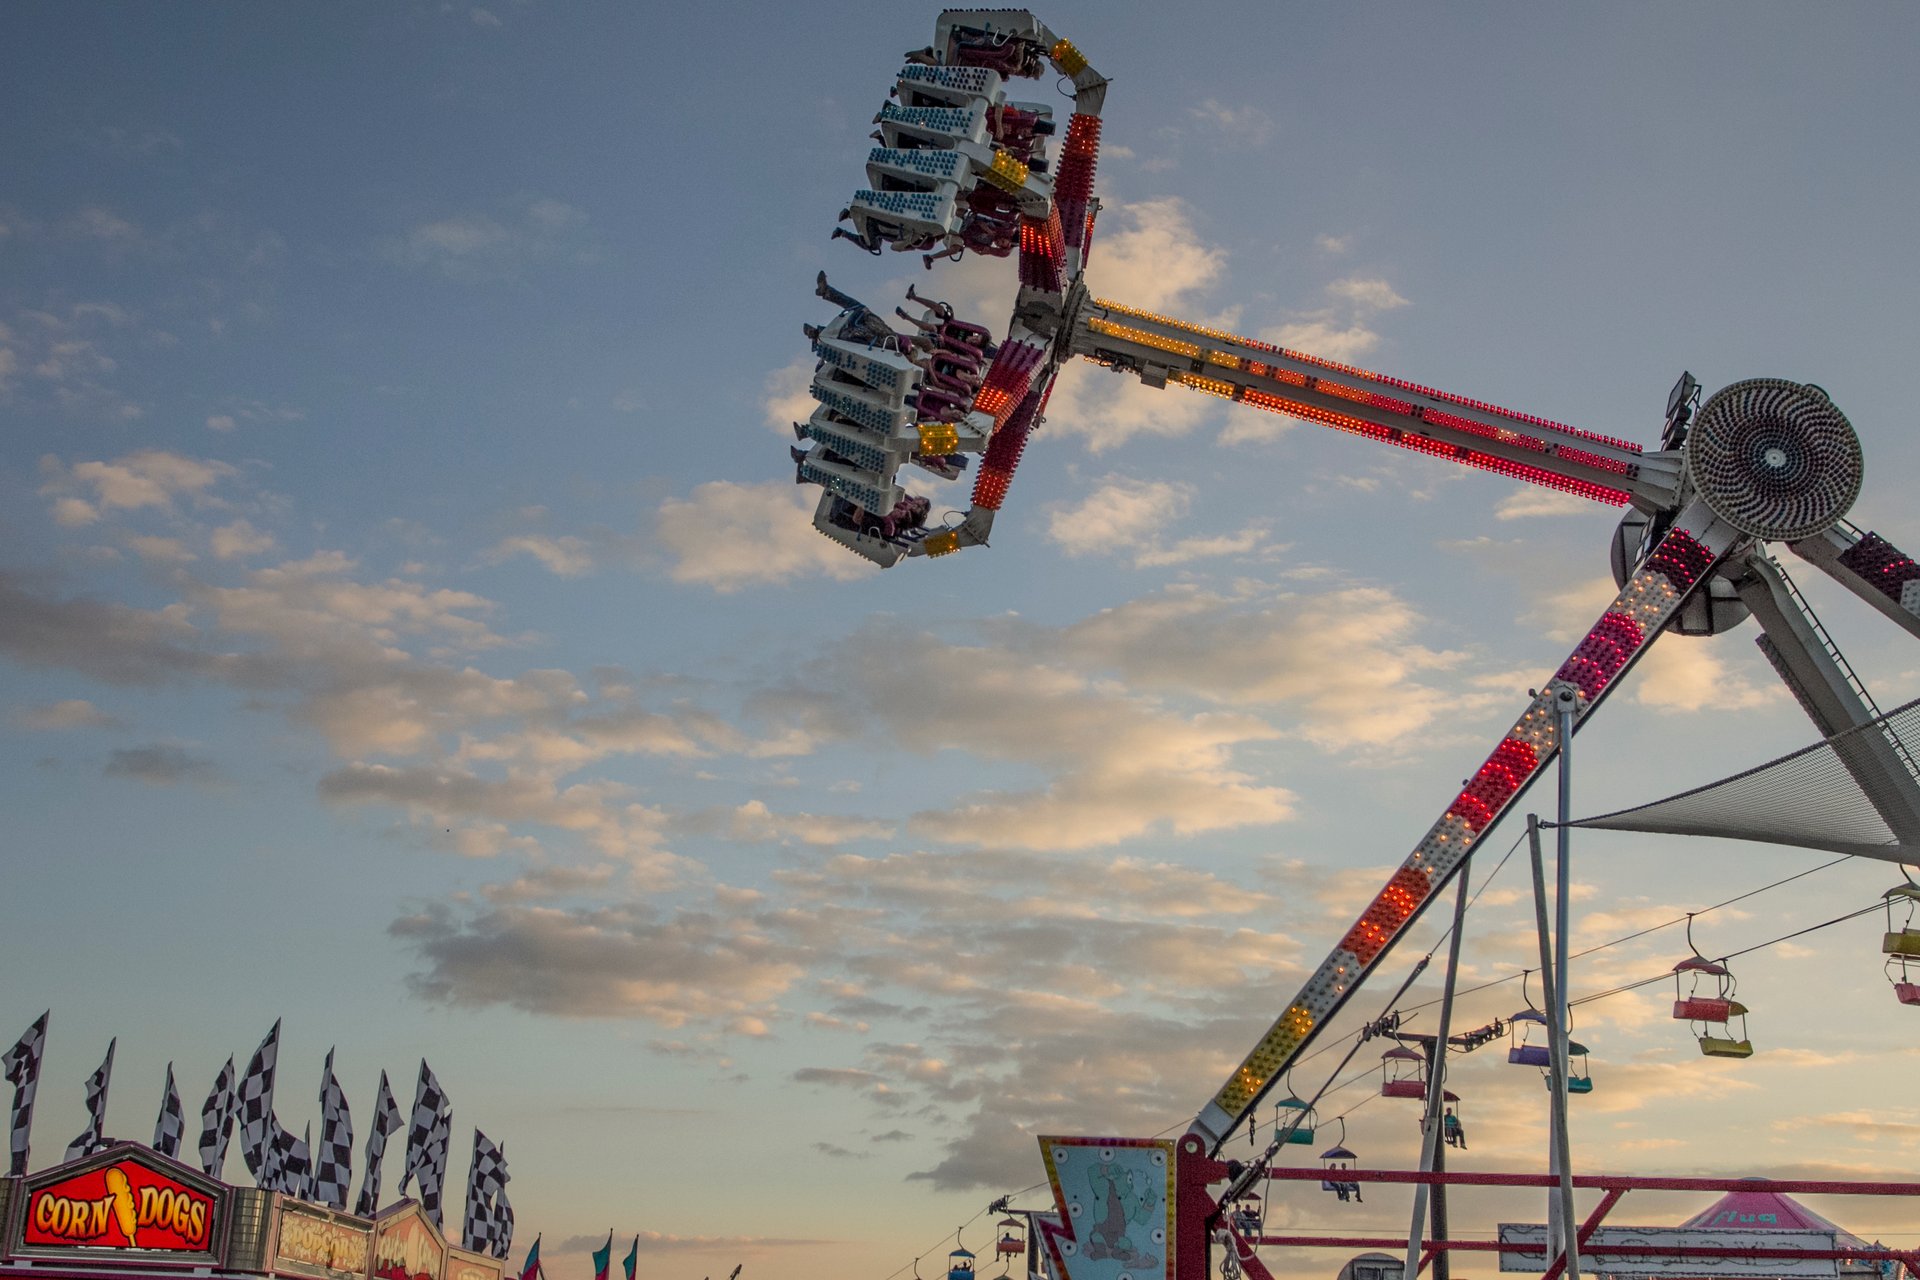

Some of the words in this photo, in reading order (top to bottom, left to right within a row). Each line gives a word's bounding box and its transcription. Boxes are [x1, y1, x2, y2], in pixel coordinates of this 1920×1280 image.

[36, 1192, 116, 1238] CORN
[139, 1186, 206, 1243] DOGS
[292, 1225, 360, 1259] POPCORN
